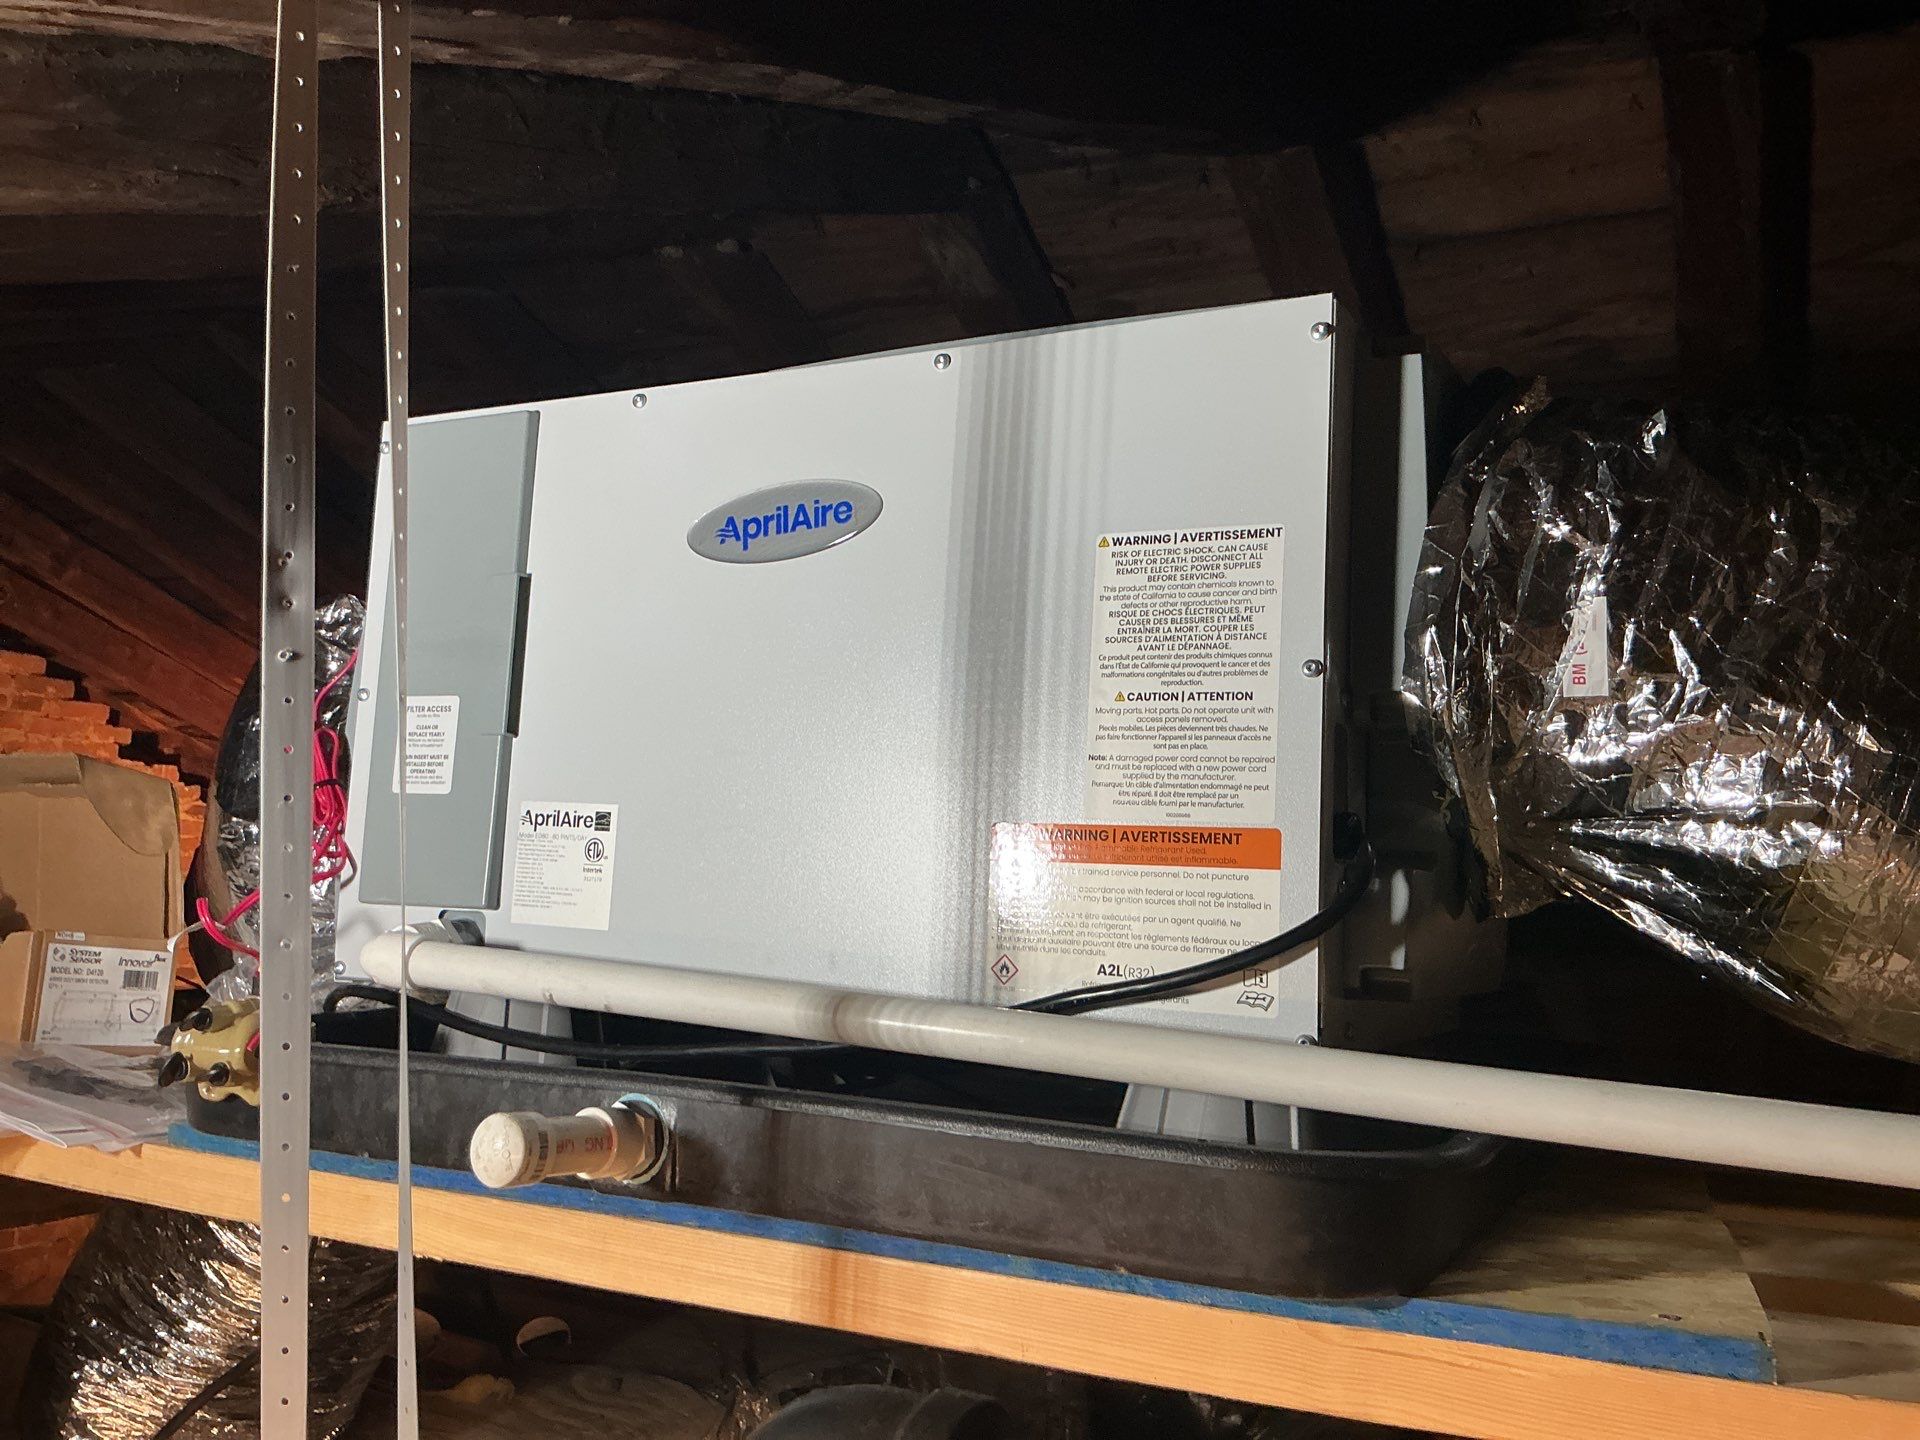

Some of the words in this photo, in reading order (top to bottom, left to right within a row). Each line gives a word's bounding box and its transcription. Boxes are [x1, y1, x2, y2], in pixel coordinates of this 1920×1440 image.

[715, 500, 853, 550] AprilAire
[1112, 534, 1171, 547] WARNING
[1180, 528, 1283, 543] AVERTISSEMENT
[1111, 550, 1128, 558] RISK
[1130, 549, 1141, 557] OF
[1143, 547, 1181, 557] ELECTRIC
[1183, 546, 1215, 555] SHOCK.
[1217, 544, 1236, 553] CAN
[1238, 543, 1267, 552] CAUSE
[1115, 558, 1144, 567] INJURY
[1145, 557, 1157, 565] OR
[1159, 556, 1188, 565] DEATH.
[1190, 553, 1246, 563] DISCONNECT
[1248, 552, 1262, 560] ALL
[1116, 566, 1148, 575] REMOTE
[1150, 564, 1188, 574] ELECTRIC
[1190, 563, 1220, 572] POWER
[1223, 561, 1261, 570] SUPPLIES
[1147, 574, 1177, 583] BEFORE
[1180, 571, 1226, 581] SERVICING.
[1118, 583, 1147, 594] product
[1148, 584, 1166, 592] may
[1166, 582, 1195, 590] contain
[1196, 580, 1237, 589] chemicals
[1238, 579, 1264, 588] known
[1112, 592, 1131, 600] state
[1141, 591, 1176, 599] California
[1259, 587, 1277, 595] birth
[1120, 600, 1148, 608] defects
[1179, 598, 1228, 608] reproductive
[1229, 597, 1252, 605] harm.
[1108, 609, 1137, 619] RISQUE
[1139, 609, 1149, 617] DE
[1151, 608, 1182, 617] CHOCS
[1184, 604, 1241, 617] ÉLECTRIQUES.
[1244, 606, 1264, 614] PEUT
[1118, 618, 1151, 626] CAUSER
[1152, 617, 1168, 625] DES
[1170, 616, 1214, 625] BLESSURES
[1174, 625, 1200, 633] MORT.
[1202, 624, 1238, 632] COUPER
[1240, 623, 1254, 631] LES
[1104, 635, 1142, 644] SOURCES
[1224, 632, 1266, 641] DISTANCE
[1136, 643, 1164, 651] AVANT
[1177, 640, 1231, 650] DÉPANNAGE.
[1572, 664, 1586, 685] BM
[1126, 692, 1178, 702] CAUTION
[1187, 692, 1253, 701] ATTENTION
[1095, 707, 1121, 716] Moving
[1122, 707, 1142, 716] parts.
[1158, 707, 1179, 715] parts.
[1207, 706, 1239, 715] operate
[1164, 716, 1190, 724] panels
[1115, 754, 1153, 764] damaged
[1241, 756, 1275, 765] repaired
[1143, 763, 1177, 772] replaced
[1221, 766, 1246, 774] power
[521, 809, 594, 831] AprilAire
[1119, 831, 1242, 844] AVERTISSEMENT
[51, 966, 73, 975] MODEL
